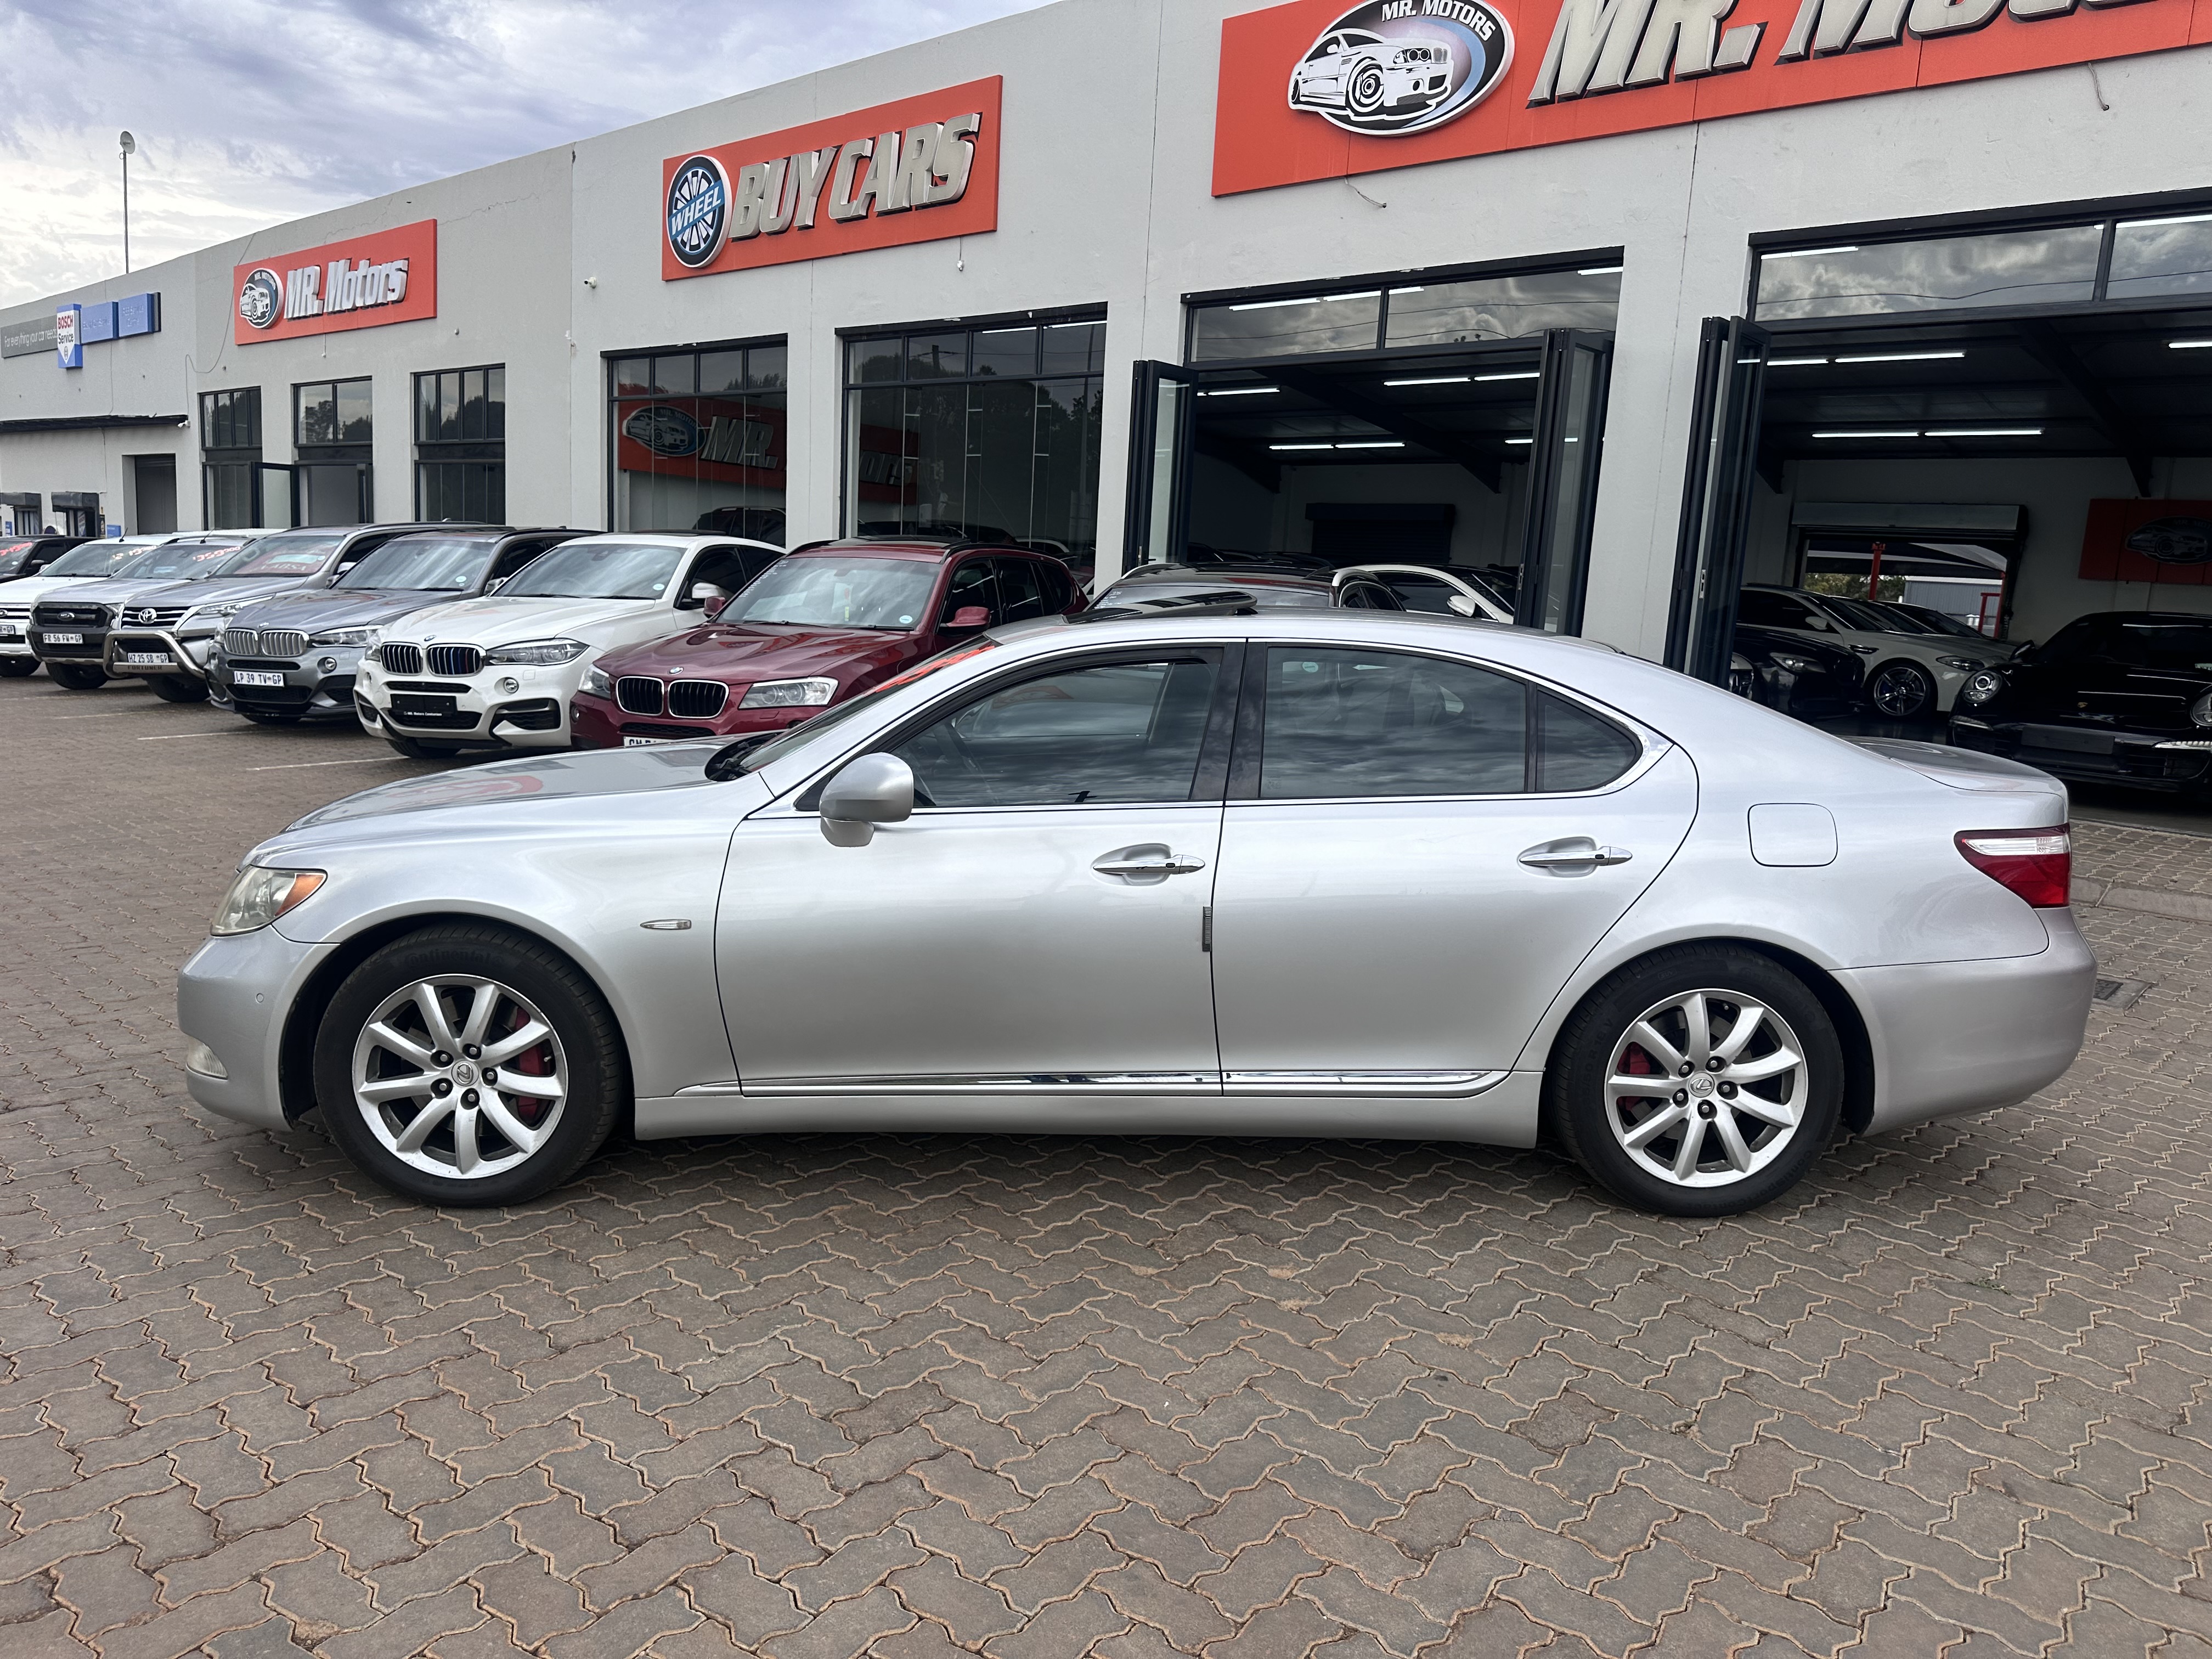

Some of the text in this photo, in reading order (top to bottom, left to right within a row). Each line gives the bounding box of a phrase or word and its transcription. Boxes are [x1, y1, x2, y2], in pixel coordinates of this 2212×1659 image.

[1381, 0, 1497, 42] MR. MOTORS
[729, 112, 981, 239] BUY CARS
[670, 185, 723, 240] WHEEL
[284, 258, 409, 319] MR. Motors
[58, 314, 74, 329] BOSCH
[58, 331, 74, 345] Service
[701, 416, 778, 470] MR.
[128, 654, 167, 663] HZ 25 SB GP
[235, 672, 281, 685] LP 39 TV GP
[404, 948, 491, 968] Continental
